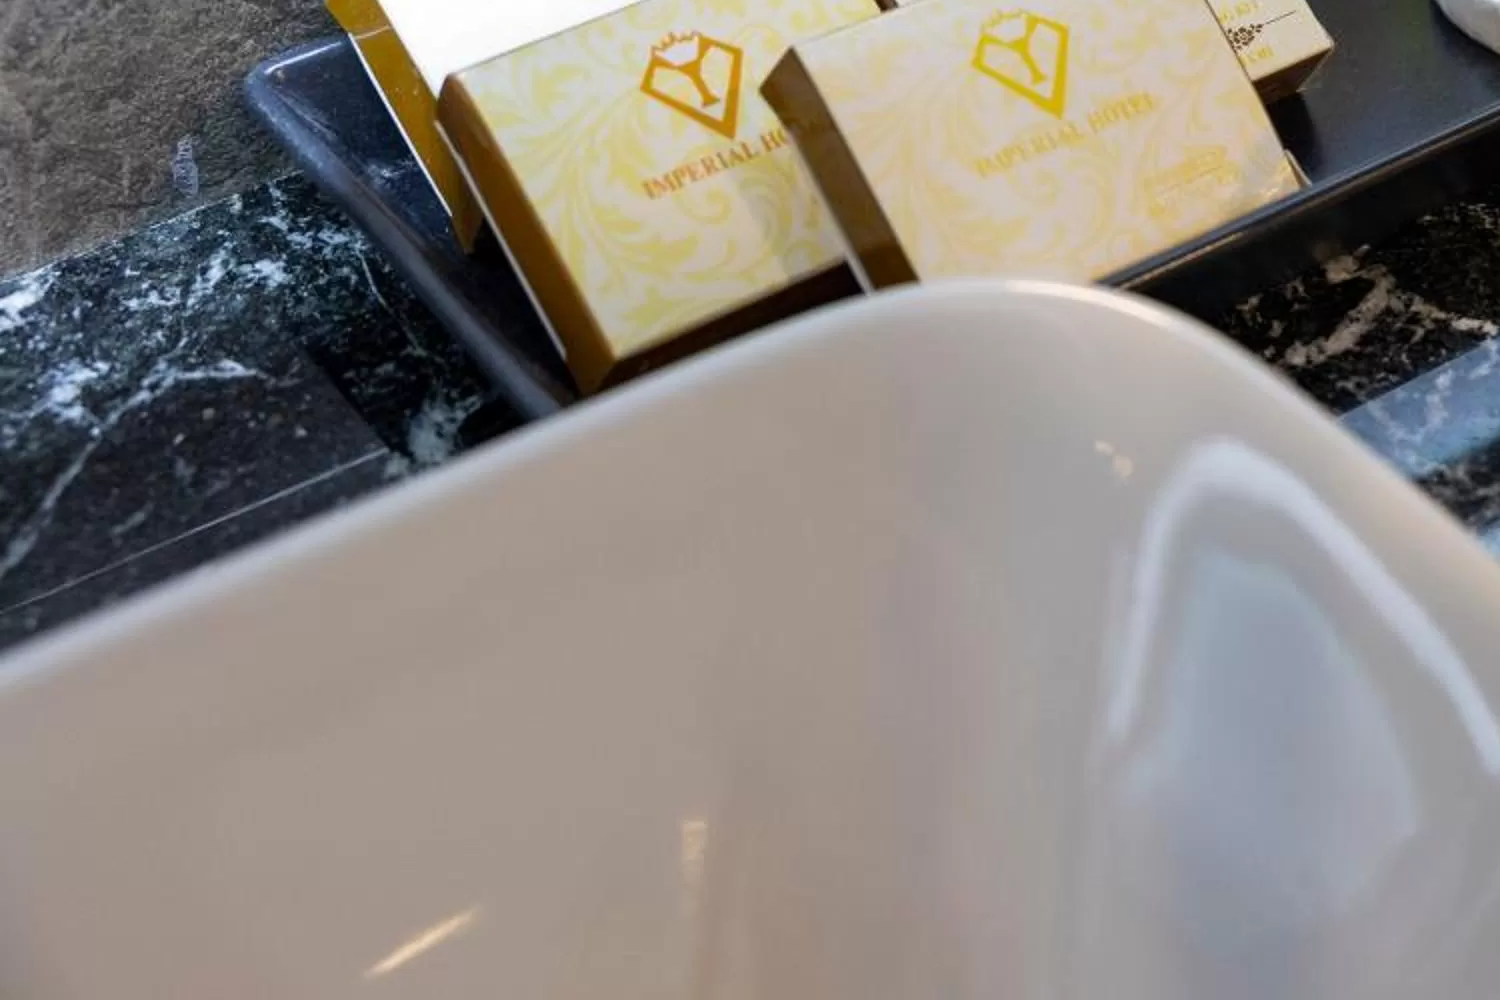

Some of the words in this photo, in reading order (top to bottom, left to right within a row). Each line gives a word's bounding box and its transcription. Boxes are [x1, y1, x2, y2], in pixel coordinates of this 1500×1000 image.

[642, 142, 760, 200] IMPERIAL
[975, 121, 1086, 179] IMPERIAL
[1087, 91, 1157, 133] HOTEL
